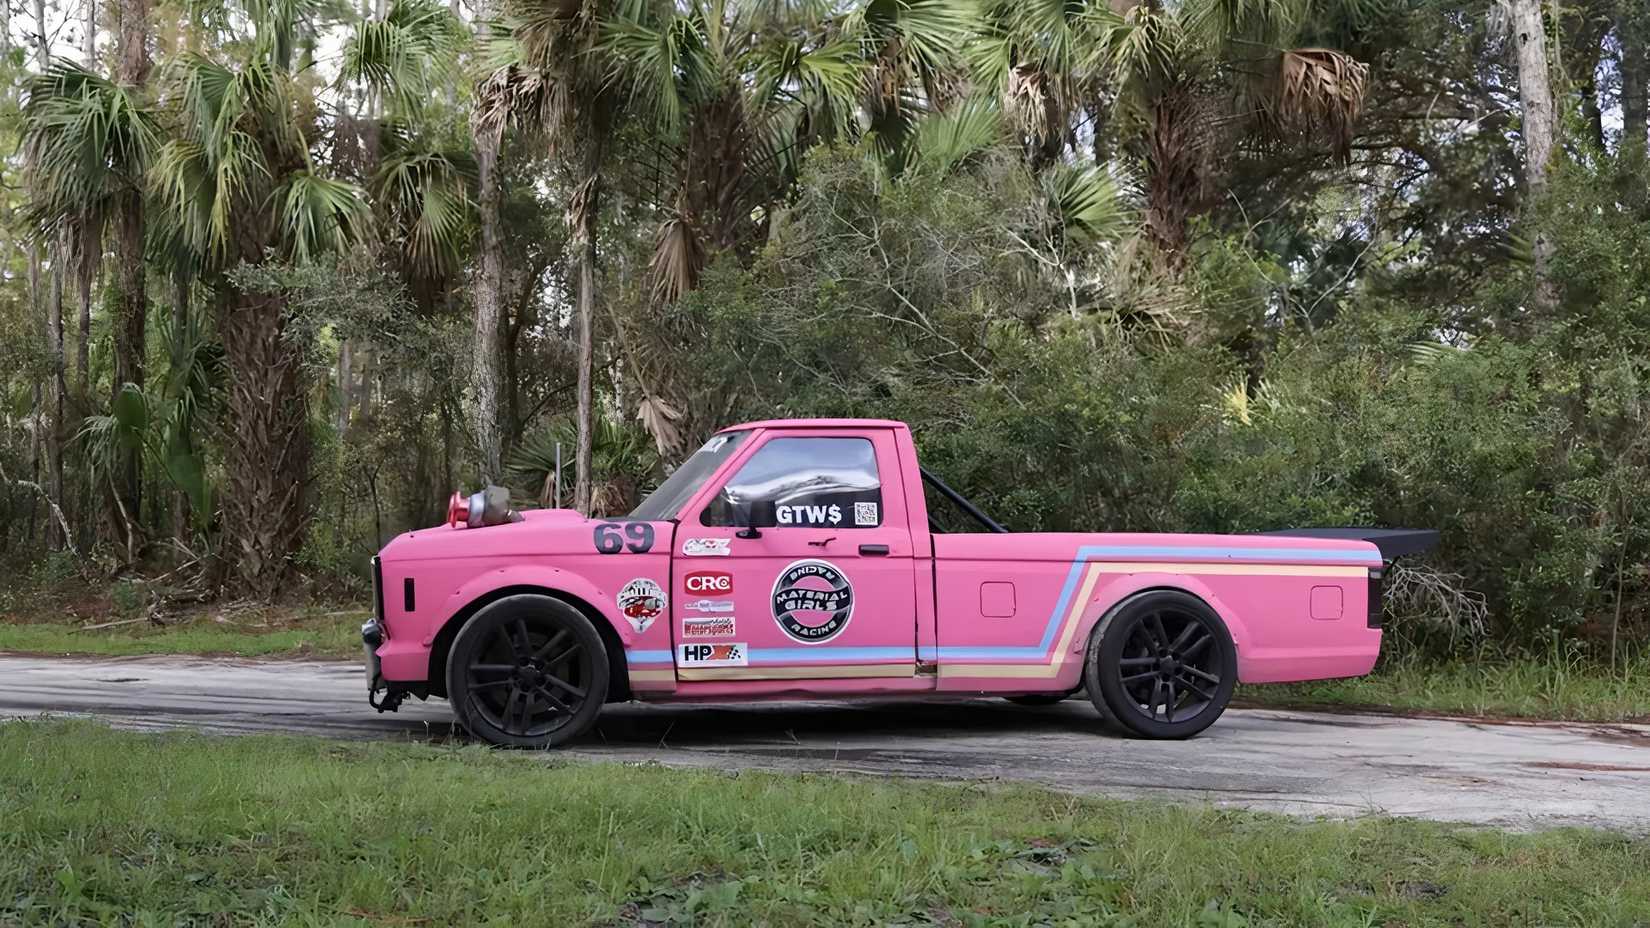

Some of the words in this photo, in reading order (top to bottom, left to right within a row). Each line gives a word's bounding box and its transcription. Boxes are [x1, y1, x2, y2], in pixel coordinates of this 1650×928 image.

[776, 504, 841, 525] GTW$
[594, 522, 655, 554] 69
[687, 576, 730, 591] CRC
[777, 590, 848, 604] MATERIAL
[785, 600, 837, 611] GIRLS
[791, 620, 836, 636] RACING
